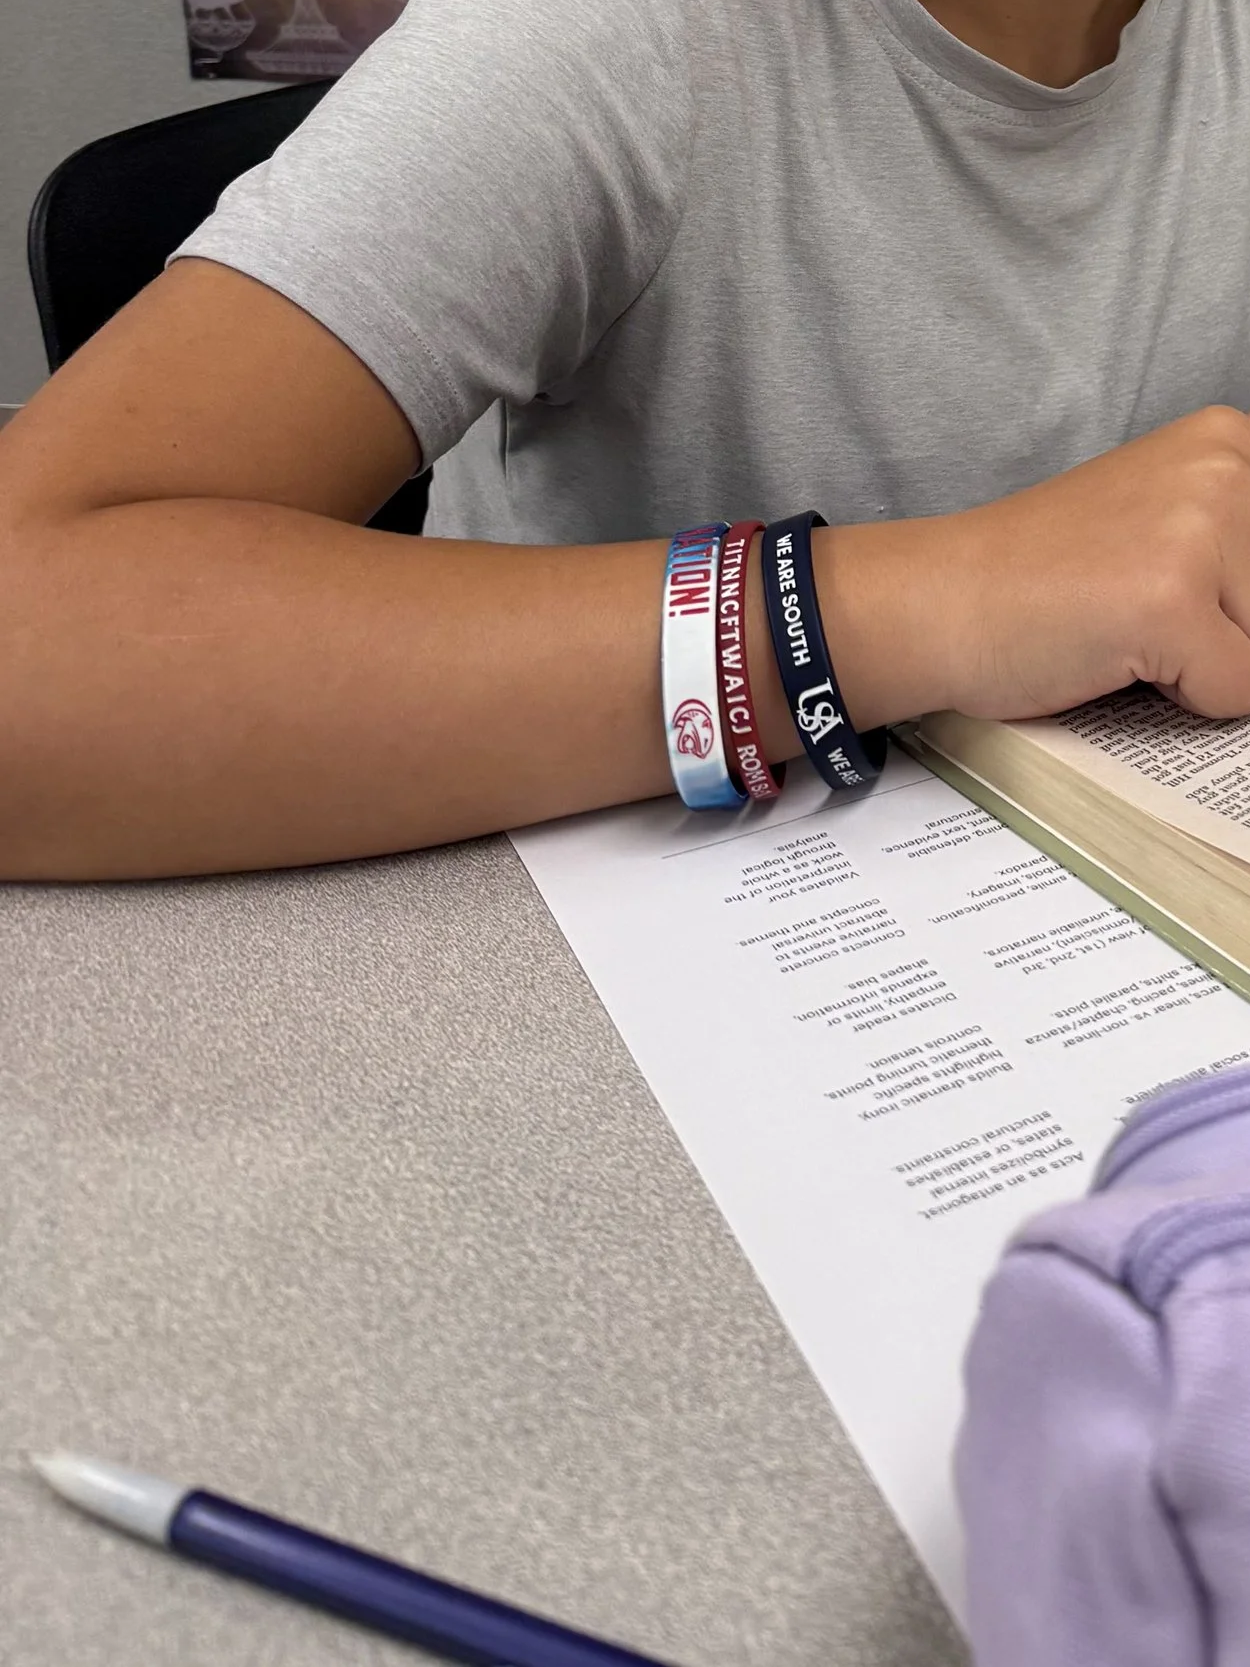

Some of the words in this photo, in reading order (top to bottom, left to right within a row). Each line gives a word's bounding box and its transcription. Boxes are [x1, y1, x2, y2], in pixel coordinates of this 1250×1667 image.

[776, 532, 793, 559] WE
[776, 559, 797, 593] ARE
[782, 593, 811, 668] SOUTH
[827, 746, 852, 772] WE
[907, 833, 972, 860] defensible
[768, 885, 797, 904] your
[798, 870, 860, 893] Validates
[1049, 908, 1110, 937] unreliable
[841, 929, 906, 954] Connects
[780, 949, 840, 974] concrete
[898, 991, 959, 1017] Dictates
[1093, 982, 1140, 1007] parallel
[852, 1012, 897, 1034] reader
[967, 1060, 1014, 1084] Builds
[900, 1077, 966, 1108] dramatic
